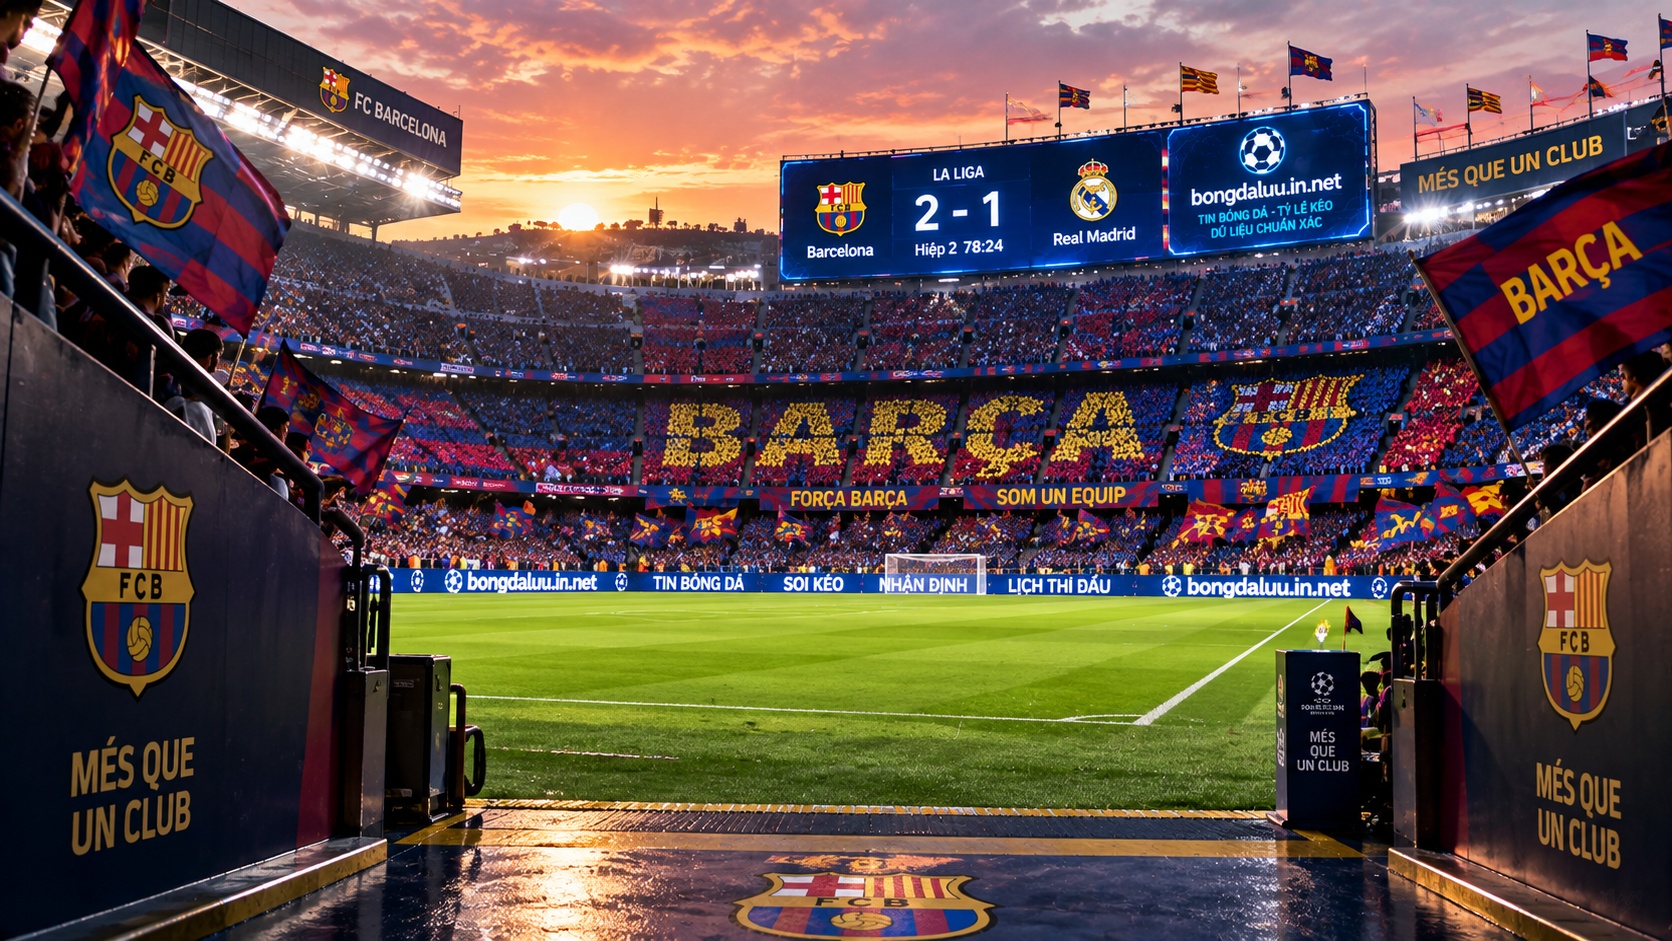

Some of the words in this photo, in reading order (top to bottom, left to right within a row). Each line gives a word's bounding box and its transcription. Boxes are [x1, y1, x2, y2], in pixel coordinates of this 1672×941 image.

[354, 91, 372, 115] FC
[374, 101, 447, 148] BARCELONA
[138, 149, 176, 184] FCB
[933, 167, 950, 182] LA
[953, 165, 985, 180] LIGA
[1418, 166, 1459, 194] MÉS
[1463, 158, 1505, 188] QUE
[1510, 150, 1541, 175] UN
[1546, 134, 1604, 167] CLUB
[1191, 173, 1343, 207] bongdaluu.in.net
[915, 194, 939, 232] 2
[982, 190, 999, 227] 1
[1197, 213, 1216, 225] TIN
[1299, 215, 1323, 230] XÁC
[948, 241, 957, 255] 2
[963, 238, 1004, 254] 78:24
[1052, 230, 1084, 247] Real
[1086, 226, 1137, 244] Madrid
[806, 243, 874, 260] Barcelona
[1499, 219, 1644, 326] BARÇA
[662, 391, 1145, 479] BARÇA
[790, 489, 846, 510] FORÇA
[850, 489, 909, 510] BARÇA
[996, 487, 1036, 506] SOM
[1041, 487, 1066, 505] UN
[1071, 486, 1127, 508] EQUIP
[119, 571, 163, 600] FCB
[467, 571, 599, 594] bongdaluu.in.net
[652, 575, 677, 591] TIN
[680, 572, 721, 591] BÓNG
[783, 575, 809, 592] SOI
[813, 573, 845, 592] KÉO
[1187, 576, 1352, 599] bongdaluu.in.net
[1560, 630, 1590, 653] FCB
[1309, 727, 1336, 743] MÉS
[1309, 744, 1336, 760] QUE
[70, 735, 135, 798] MÉS
[142, 736, 195, 791] QUE
[1296, 759, 1315, 772] UN
[1317, 759, 1350, 772] CLUB
[1535, 758, 1575, 806] MÉS
[1579, 772, 1622, 820] QUE
[71, 803, 116, 856] UN
[123, 790, 192, 844] CLUB
[1537, 807, 1564, 851] UN
[1568, 817, 1621, 870] CLUB
[815, 897, 910, 908] FCB
